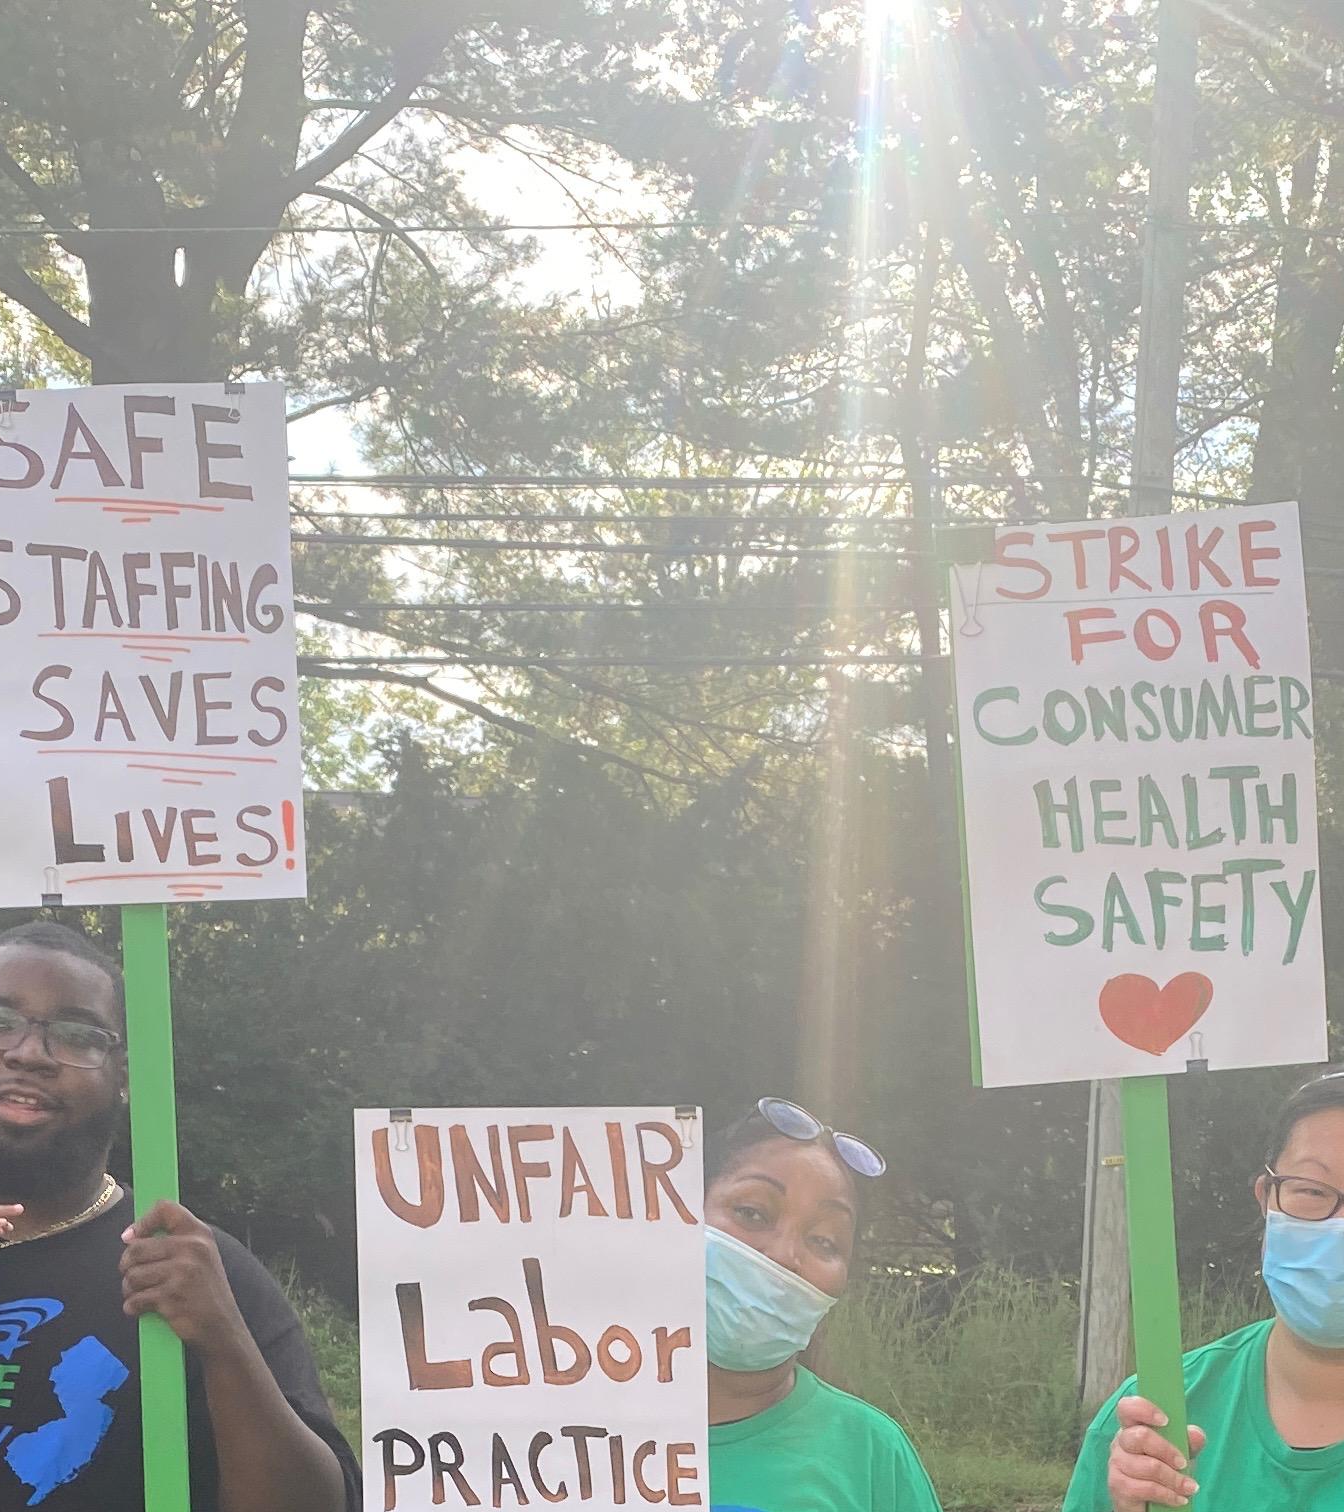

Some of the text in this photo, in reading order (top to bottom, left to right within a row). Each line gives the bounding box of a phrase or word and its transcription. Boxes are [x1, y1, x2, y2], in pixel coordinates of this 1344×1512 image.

[995, 520, 1282, 600] STRIKE
[1064, 600, 1261, 669] FOR
[20, 665, 287, 747] SAVES
[973, 675, 1313, 746] CONSUMER
[46, 776, 295, 871] LIVES!
[1032, 766, 1298, 853] HEALTH
[1033, 859, 1316, 965] SAFETY
[372, 1121, 698, 1229] UNFAIR
[396, 1258, 692, 1390] Labor
[373, 1426, 702, 1512] PRACTICE
